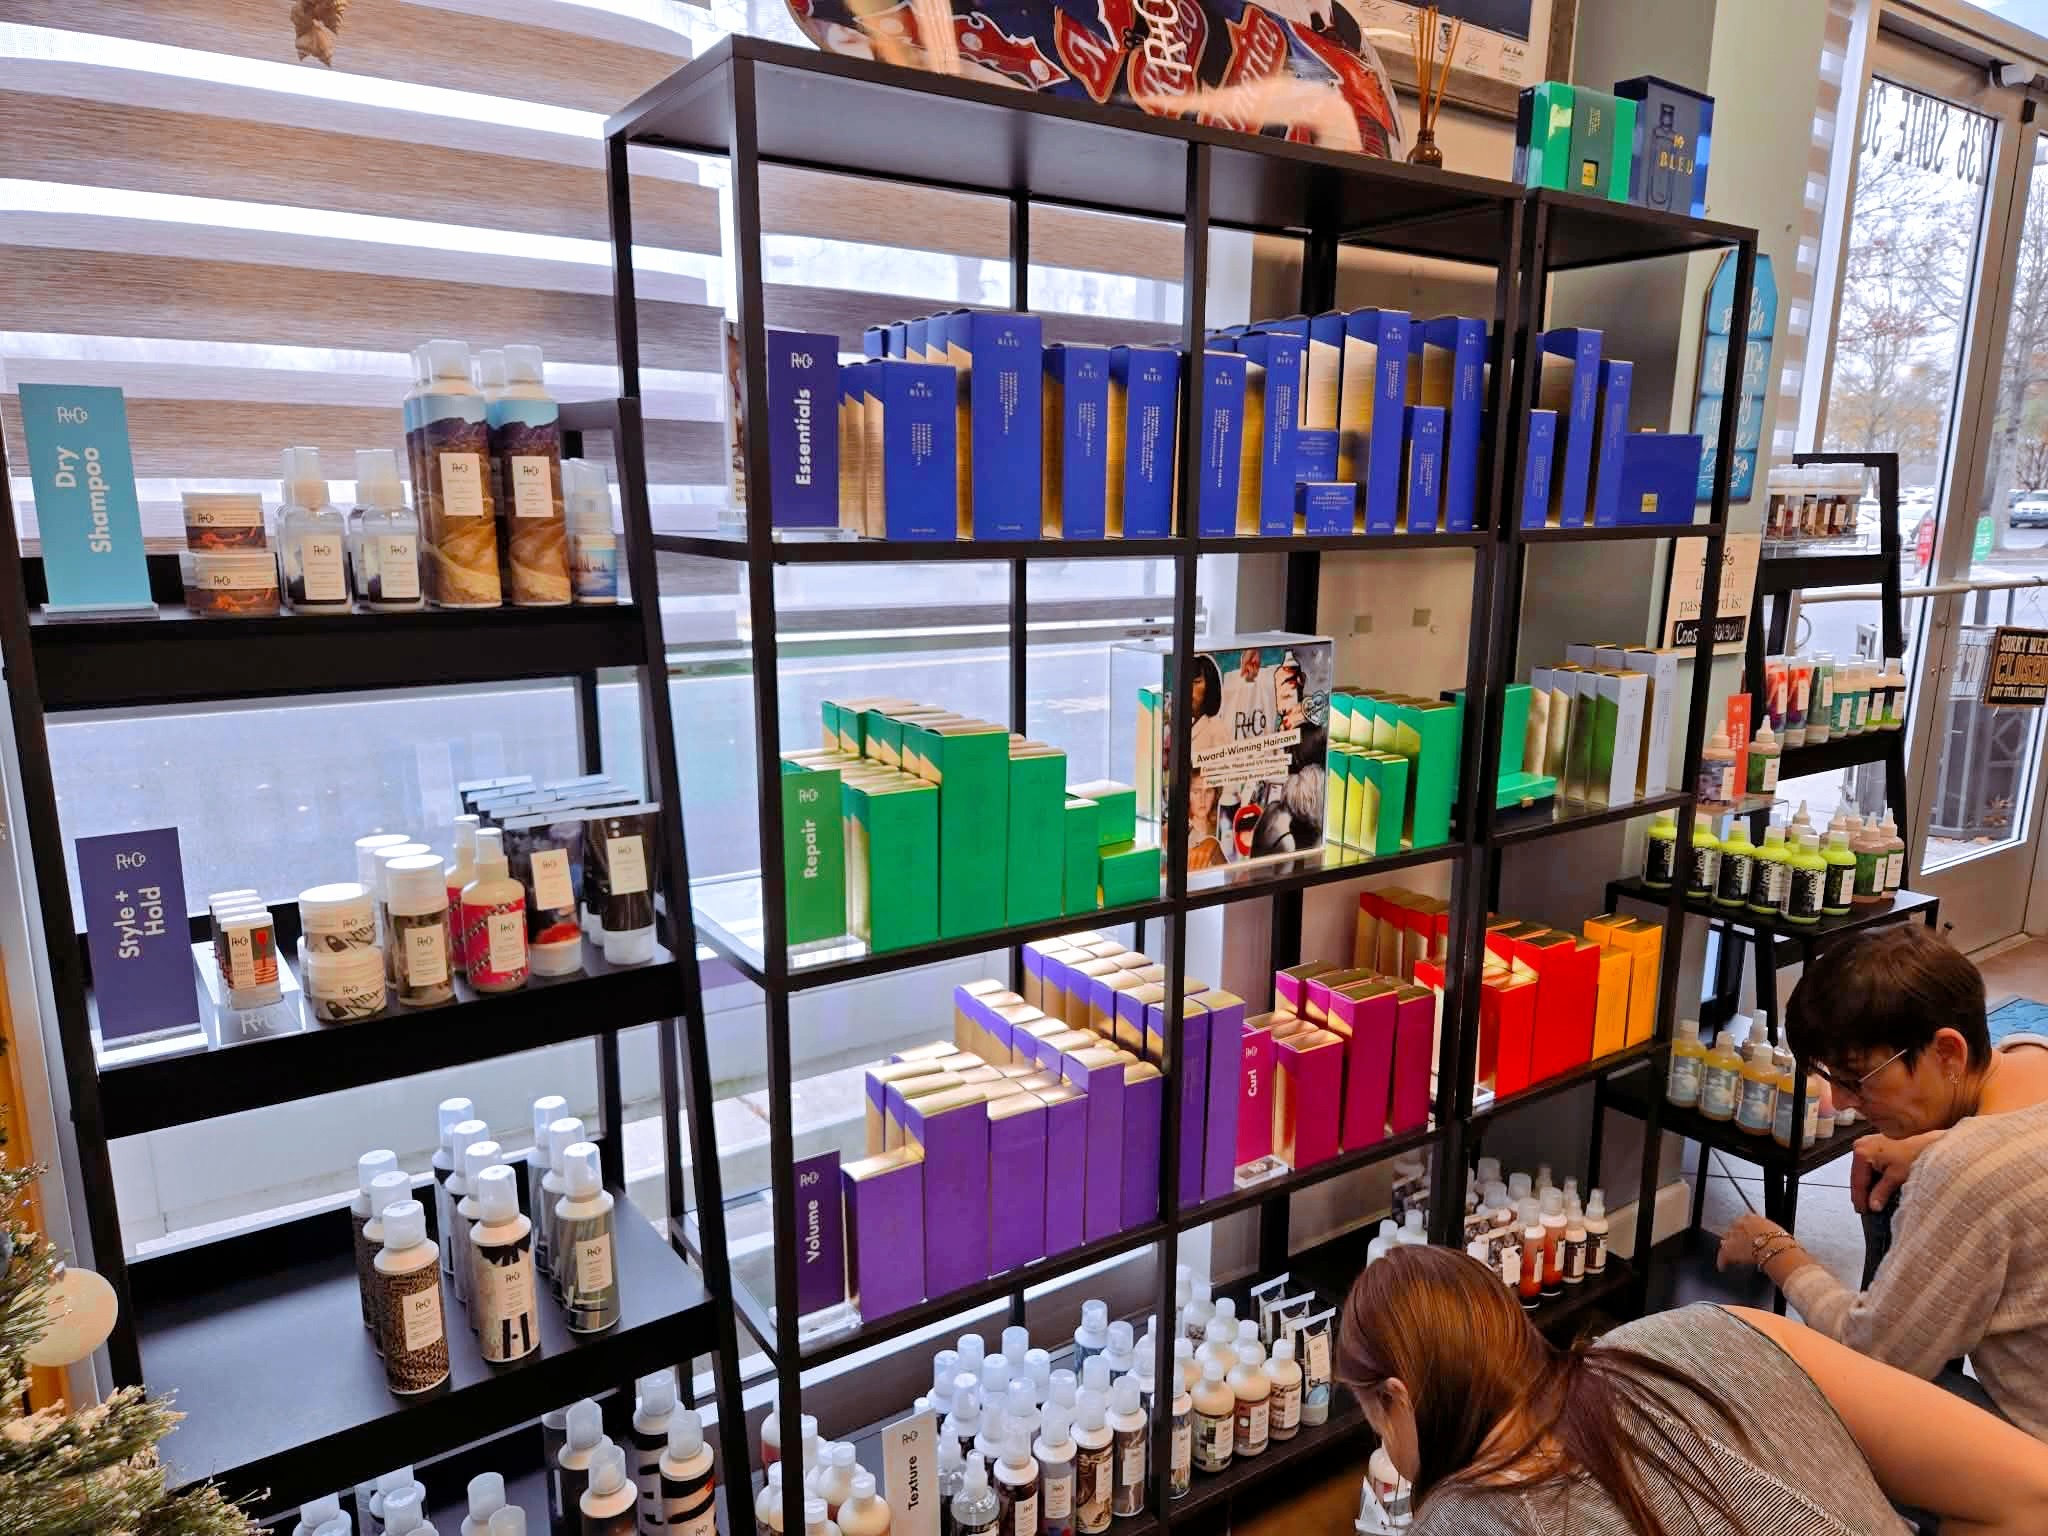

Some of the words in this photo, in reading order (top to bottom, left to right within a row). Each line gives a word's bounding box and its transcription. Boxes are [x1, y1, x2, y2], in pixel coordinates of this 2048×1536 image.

[1659, 150, 1694, 176] BLEU
[791, 352, 813, 368] R+Co
[56, 406, 88, 424] R+Co
[794, 388, 811, 485] Essentials
[55, 446, 80, 488] Dry
[84, 447, 112, 553] Shampoo
[1999, 634, 2028, 653] SORRY
[1234, 708, 1267, 741] R+Co
[1196, 742, 1262, 763] Award-Winning
[1263, 733, 1297, 748] Haircare
[116, 852, 146, 870] R+Co
[801, 819, 821, 879] Repair
[115, 890, 129, 902] +
[138, 886, 166, 936] Hold
[113, 907, 144, 960] Style
[1248, 1068, 1257, 1097] Curl
[800, 1171, 819, 1188] R+Co
[805, 1200, 820, 1263] Volume
[908, 1455, 919, 1511] Texture
